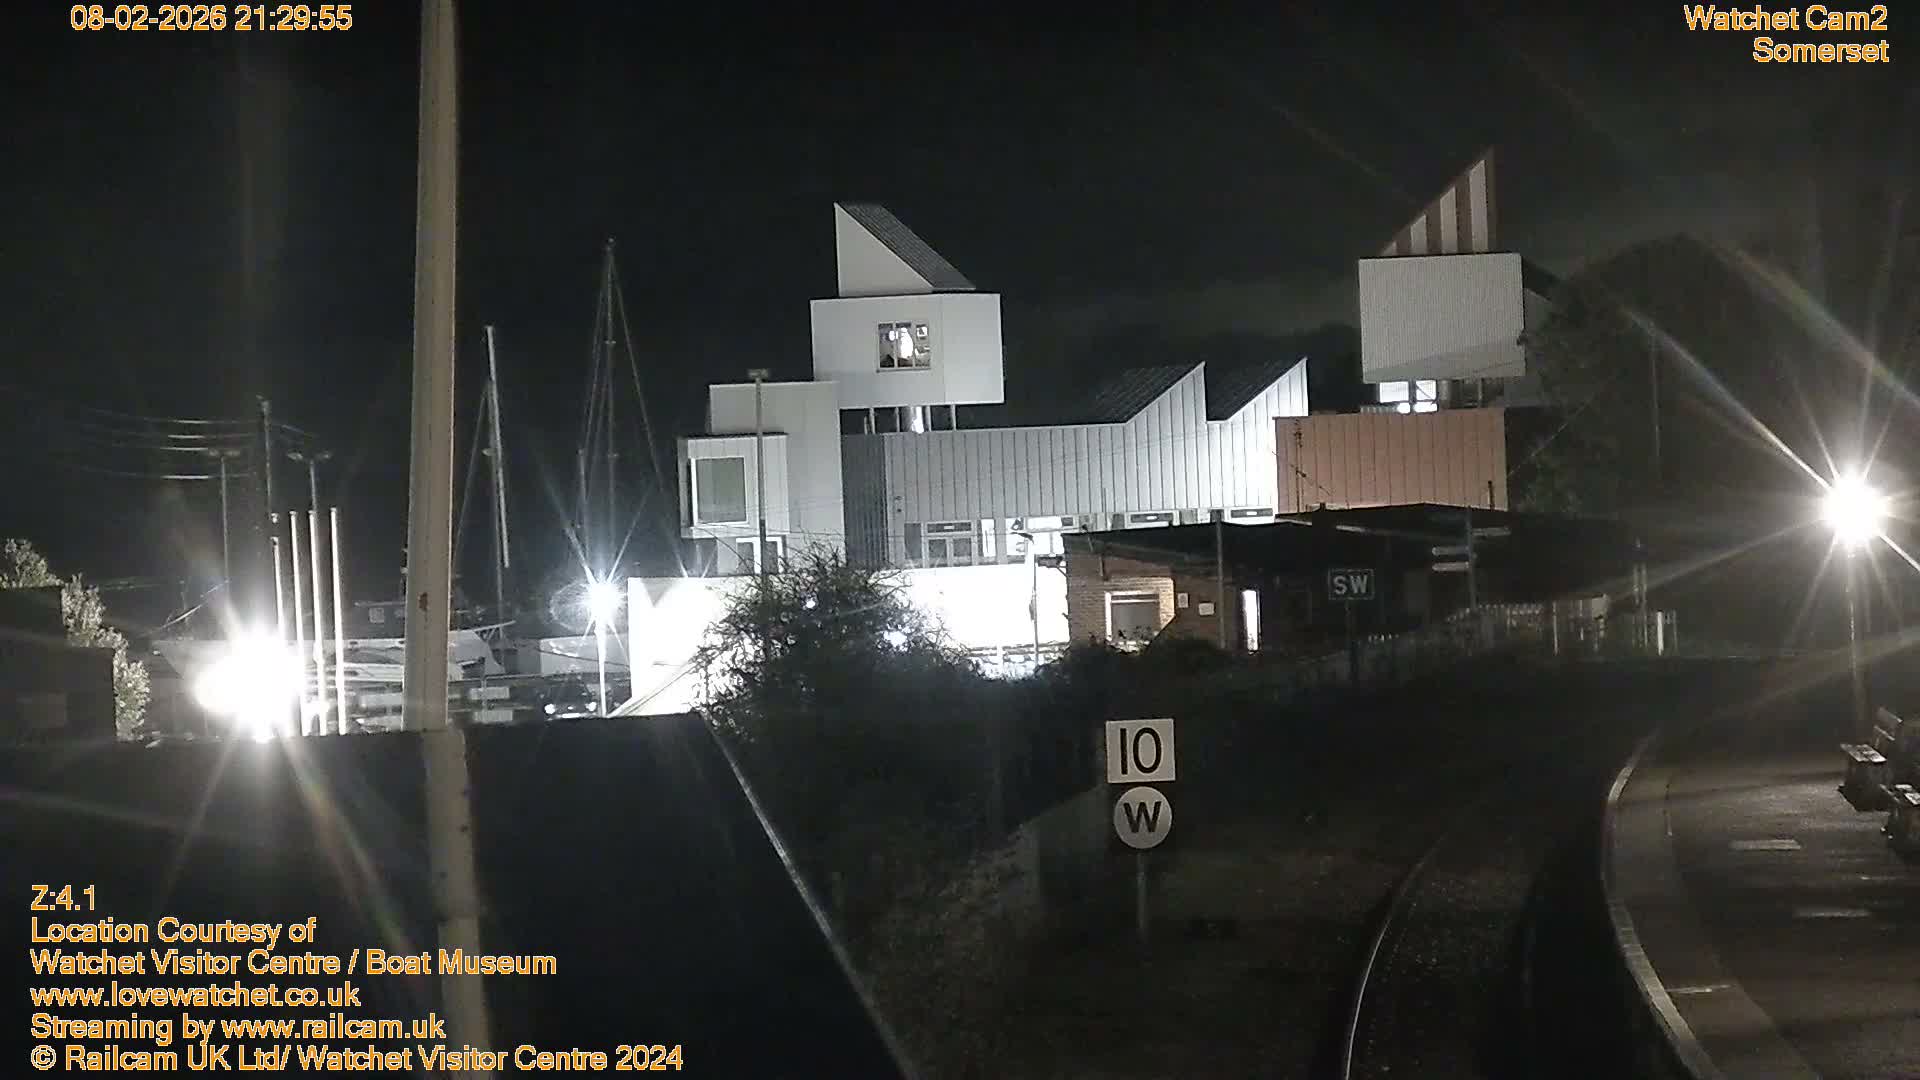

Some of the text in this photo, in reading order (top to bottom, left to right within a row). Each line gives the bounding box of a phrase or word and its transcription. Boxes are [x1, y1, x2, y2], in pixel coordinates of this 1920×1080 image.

[1333, 574, 1369, 595] SW
[1120, 727, 1162, 775] 10
[1123, 801, 1162, 833] W
